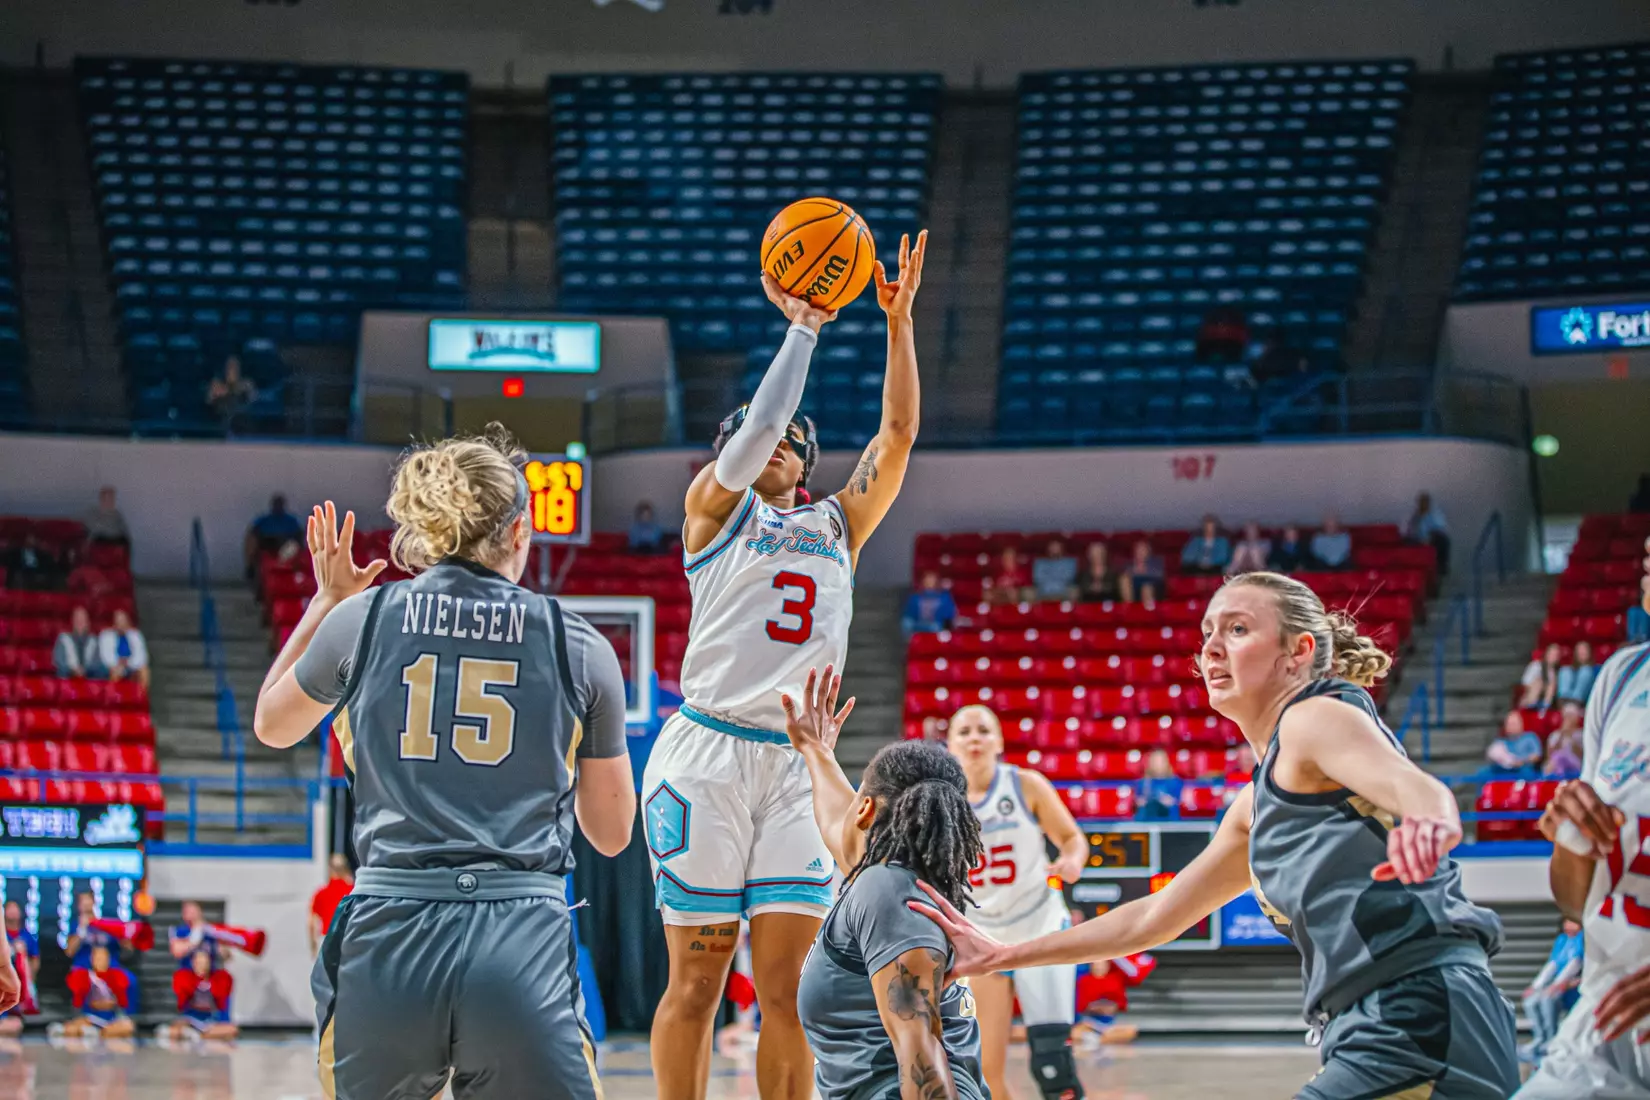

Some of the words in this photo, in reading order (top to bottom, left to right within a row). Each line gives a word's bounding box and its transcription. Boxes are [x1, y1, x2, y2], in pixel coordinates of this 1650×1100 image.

[799, 254, 849, 303] Wilso
[534, 490, 577, 533] 18
[402, 592, 527, 644] NIELSEN
[764, 569, 817, 647] 3
[399, 652, 520, 766] 15
[967, 844, 1017, 888] 25
